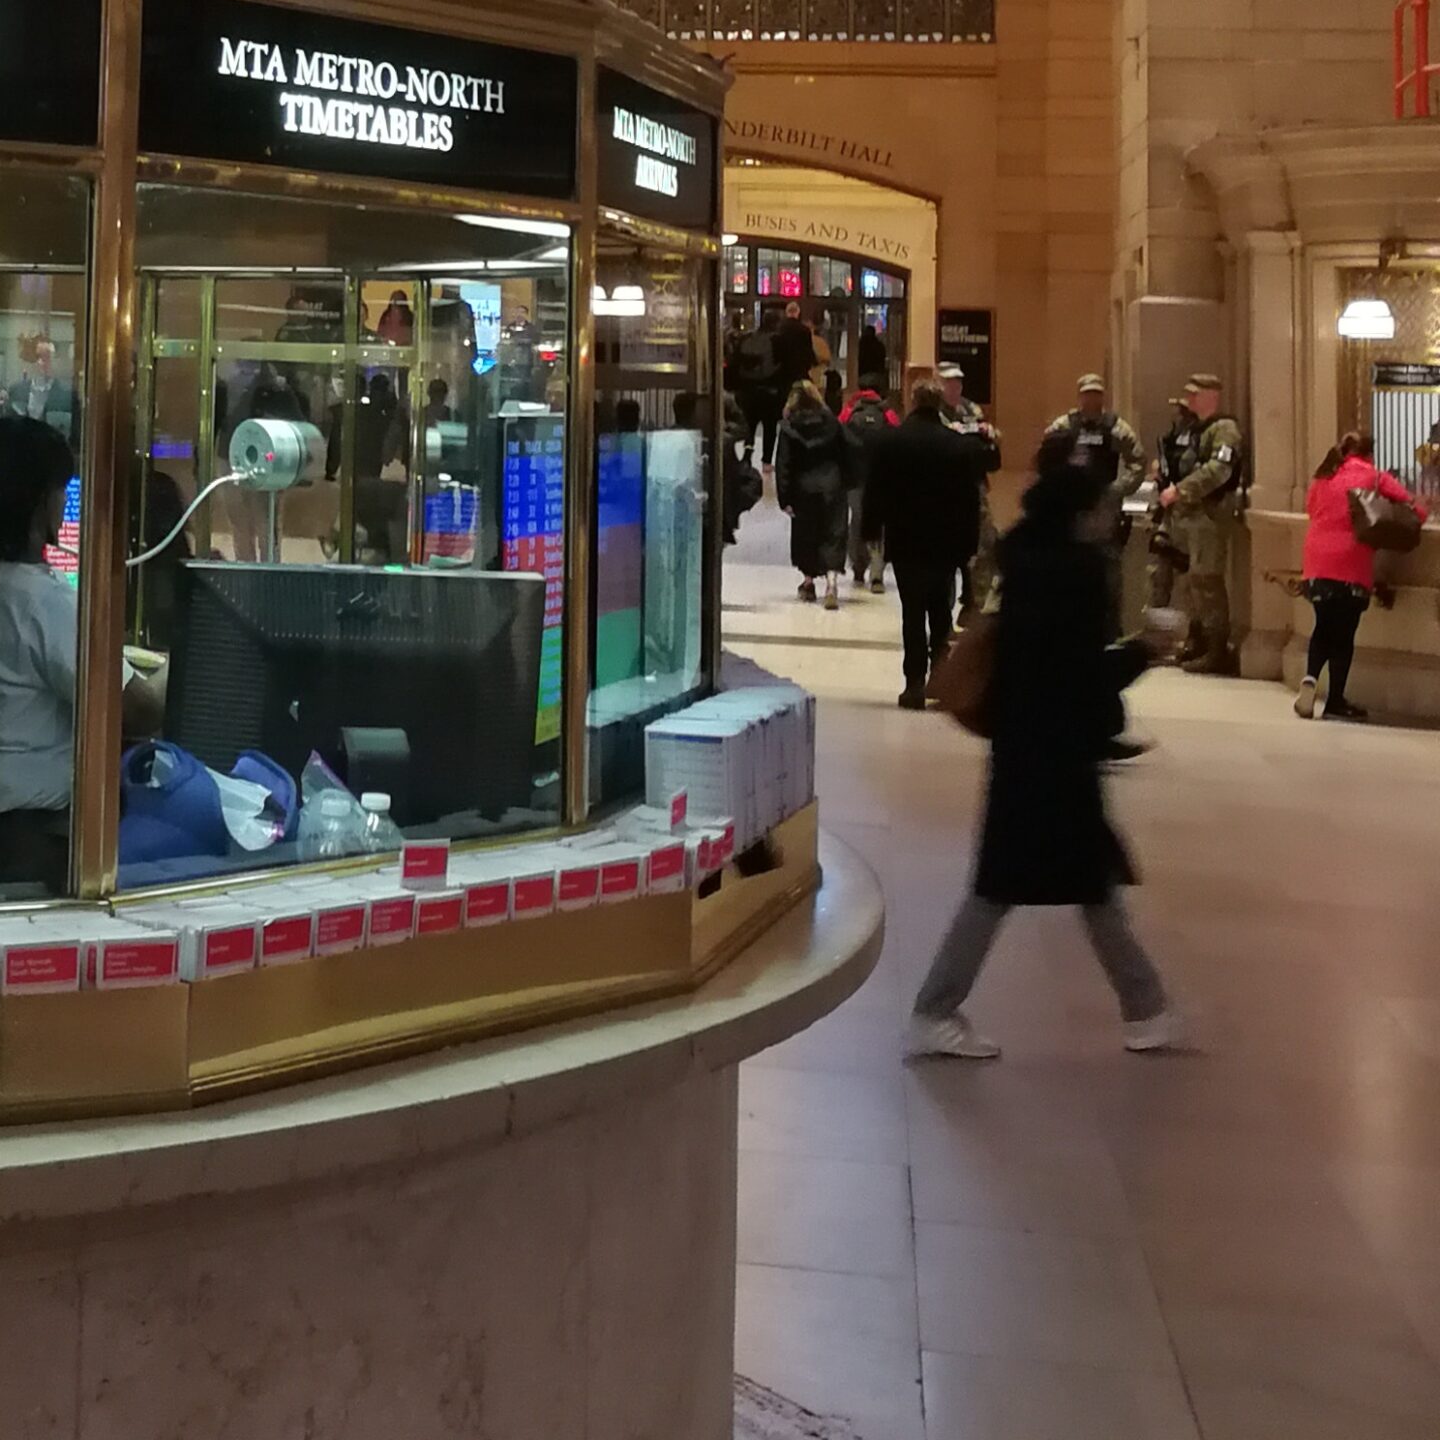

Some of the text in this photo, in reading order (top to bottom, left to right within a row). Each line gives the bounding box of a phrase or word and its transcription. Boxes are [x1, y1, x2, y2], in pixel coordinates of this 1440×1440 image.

[217, 37, 505, 115] MTA METRO-NORTH
[279, 92, 454, 152] TIMETABLES
[612, 105, 697, 167] MTA METRO-NORTH
[839, 140, 894, 168] HALL
[745, 213, 911, 260] BUSES AND TAXIS
